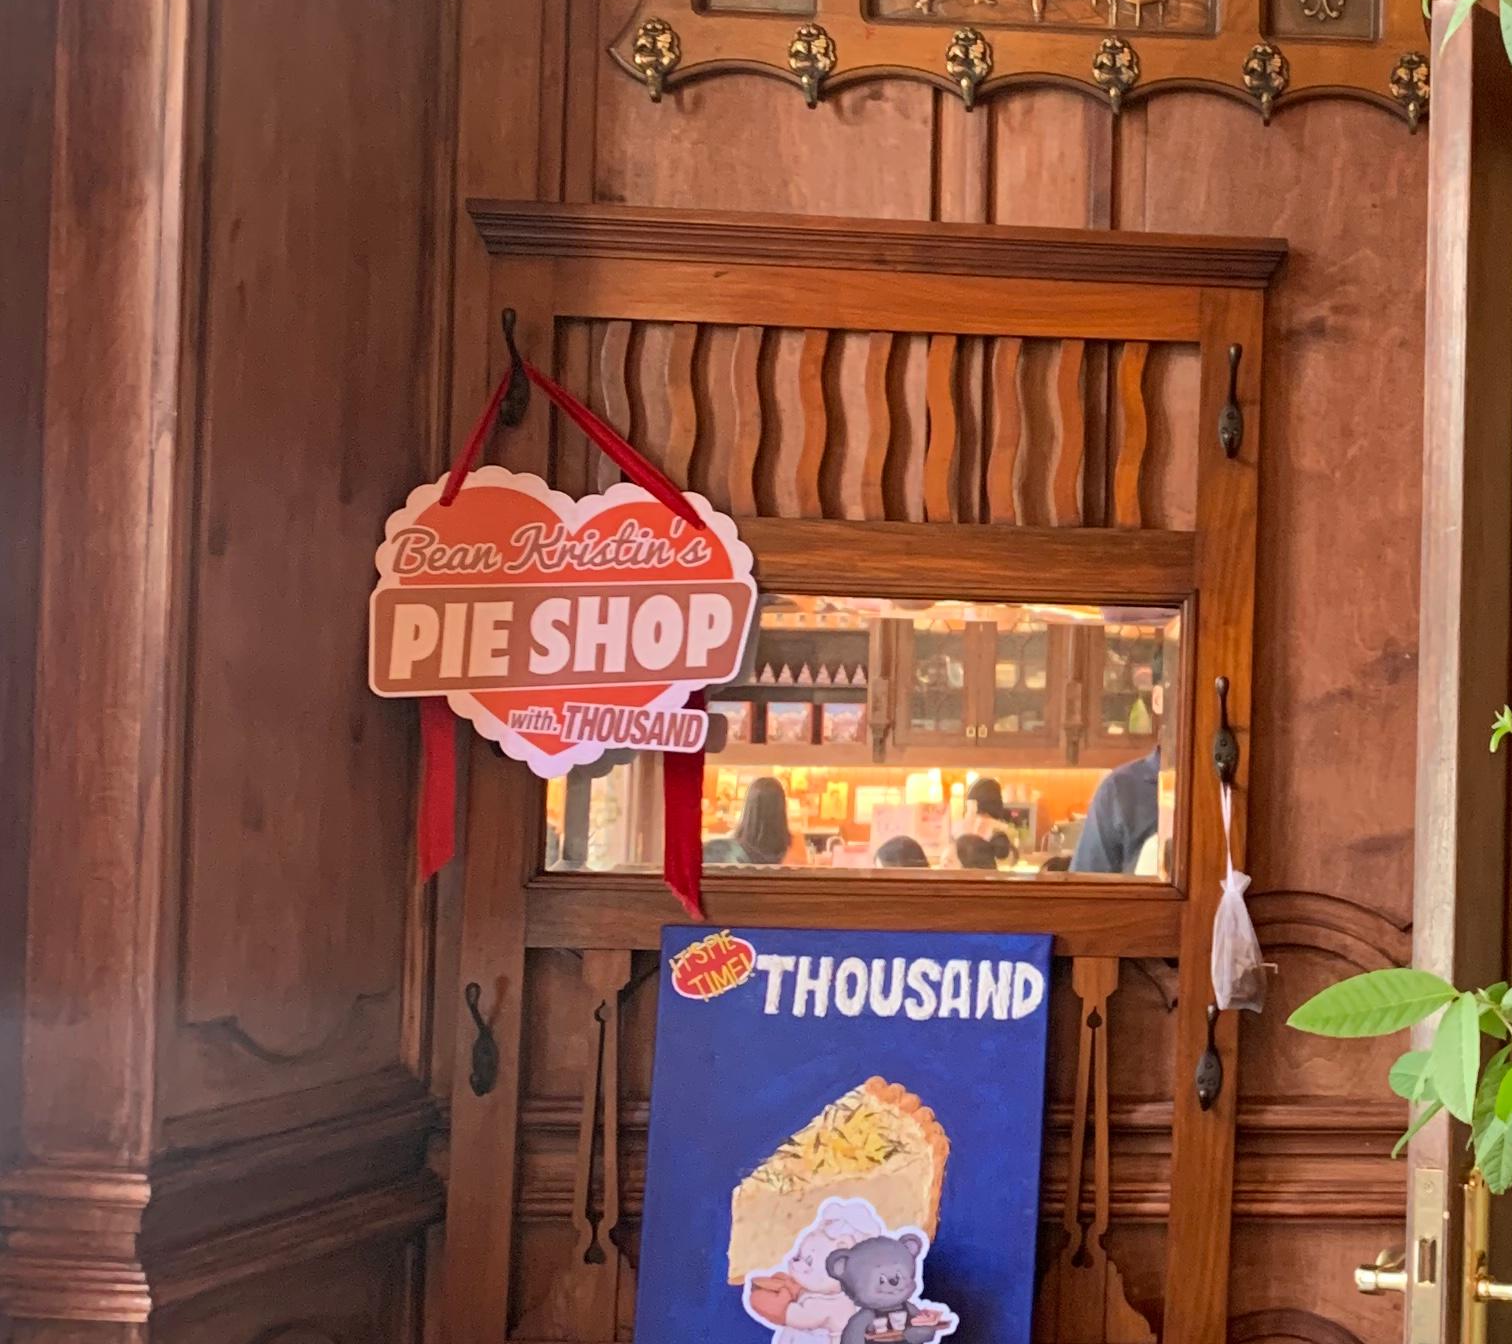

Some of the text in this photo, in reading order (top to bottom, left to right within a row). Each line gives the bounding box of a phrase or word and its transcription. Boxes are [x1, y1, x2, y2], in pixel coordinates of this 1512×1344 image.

[391, 517, 713, 576] Bean Kristin's
[388, 593, 733, 680] PIE SHOP
[563, 705, 703, 748] THOUSAND
[687, 953, 755, 1002] TIME!
[756, 954, 1045, 1021] THOUSAND
